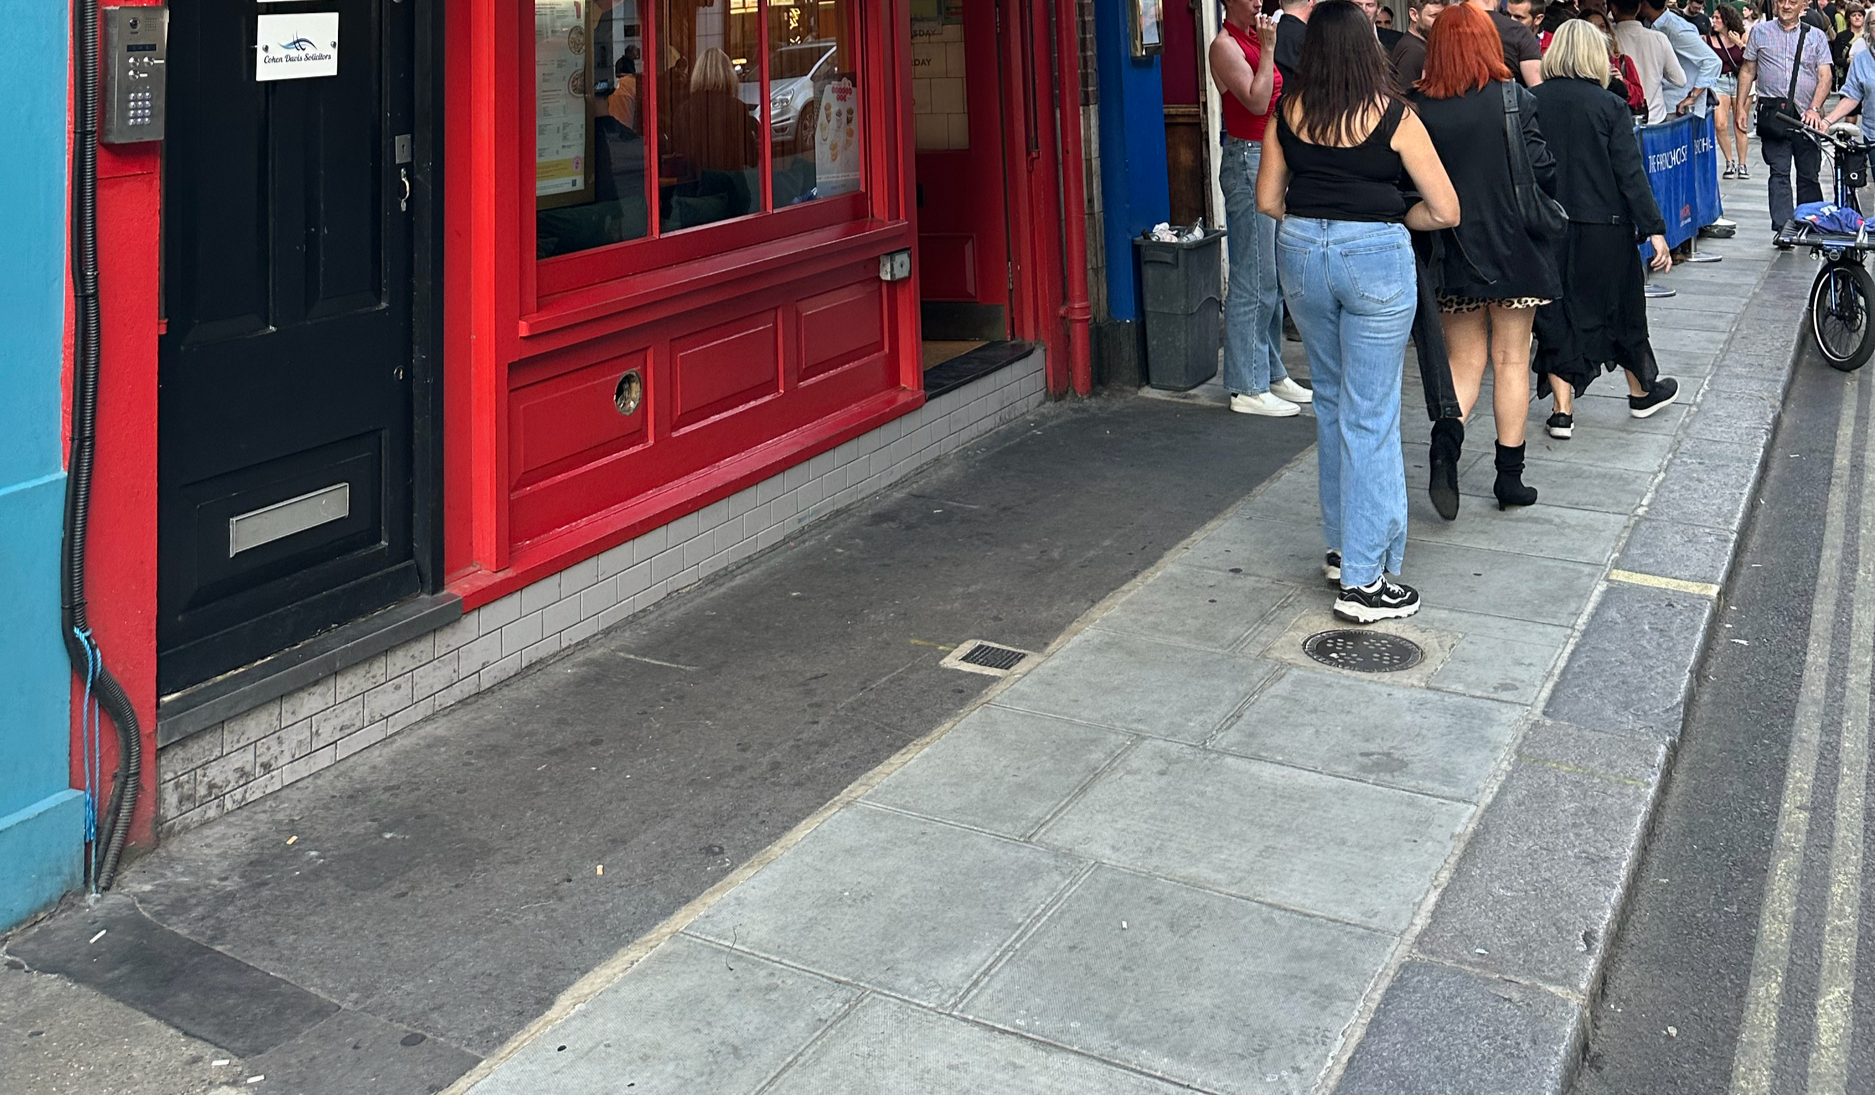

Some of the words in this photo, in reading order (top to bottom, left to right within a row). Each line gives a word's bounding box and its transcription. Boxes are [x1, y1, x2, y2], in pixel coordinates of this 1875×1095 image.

[263, 54, 283, 64] Cohen
[284, 54, 303, 62] Davis
[304, 52, 332, 62] Solicitors
